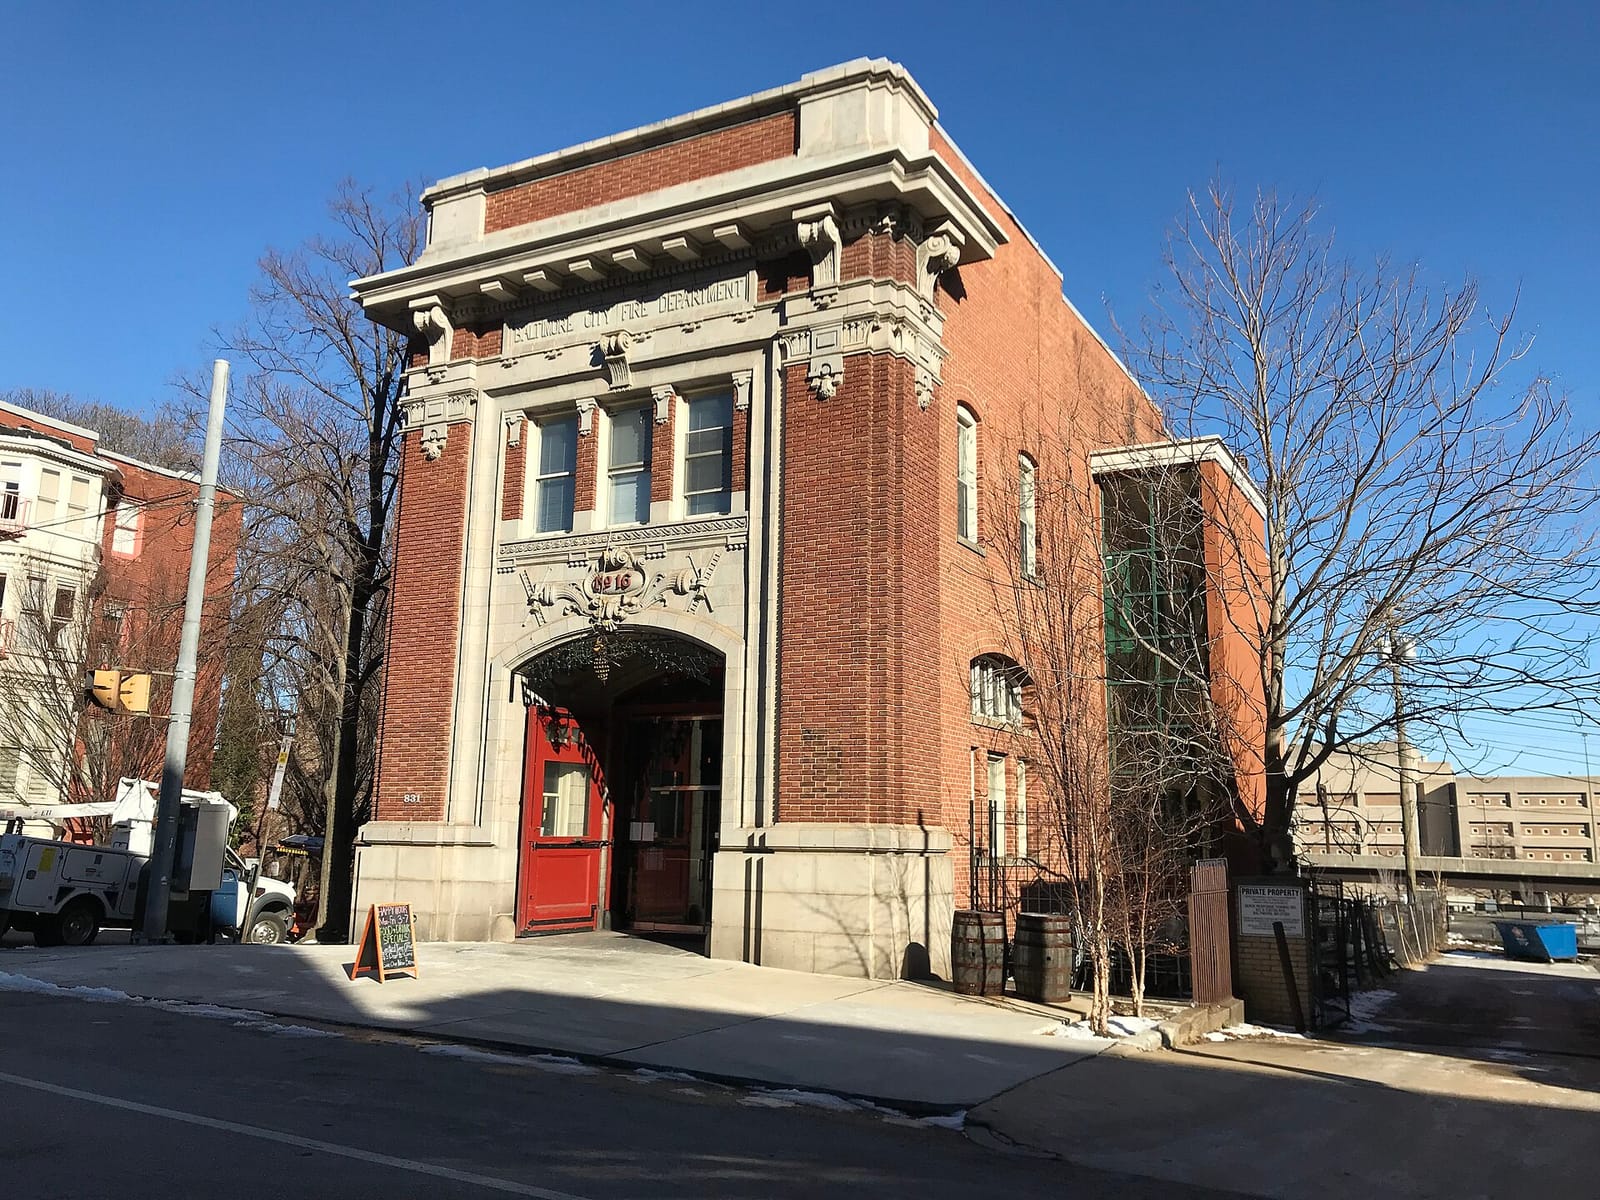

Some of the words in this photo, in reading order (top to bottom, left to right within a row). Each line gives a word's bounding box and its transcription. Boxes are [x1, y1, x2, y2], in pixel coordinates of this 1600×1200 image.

[514, 316, 574, 343] BALTIMORE
[584, 309, 609, 328] CITY
[621, 301, 648, 321] FIRE
[659, 279, 744, 313] DEPARTMENT
[615, 573, 631, 590] 16
[403, 794, 421, 803] 831
[1242, 888, 1266, 896] PRIVATE
[1267, 888, 1299, 896] PROPERTY
